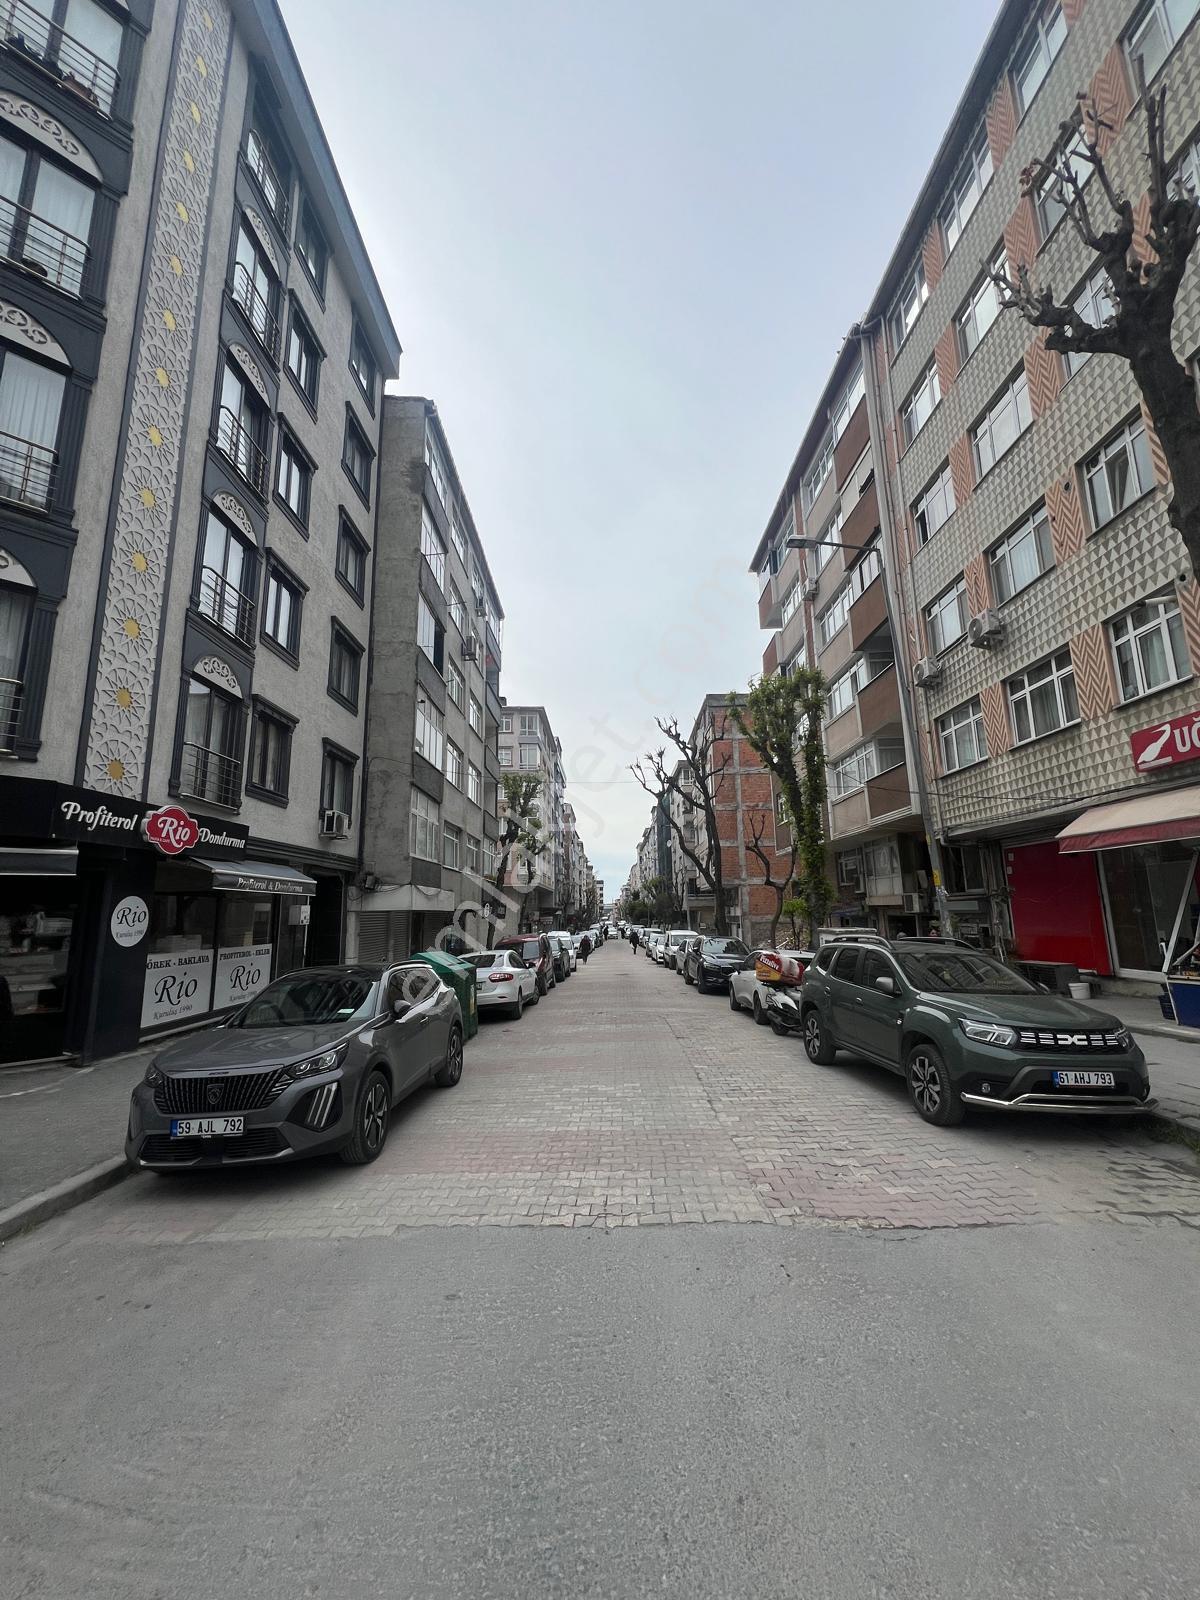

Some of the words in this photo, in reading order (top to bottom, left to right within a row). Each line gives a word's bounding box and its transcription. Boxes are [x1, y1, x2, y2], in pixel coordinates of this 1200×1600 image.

[61, 802, 138, 831] Profiterol
[158, 817, 190, 848] Rio
[200, 828, 245, 849] Dondurma
[116, 906, 147, 927] Rio
[146, 959, 172, 970] ÖREK
[230, 962, 261, 991] Rio
[154, 971, 198, 1006] Rio
[1058, 1072, 1069, 1084] 61
[1074, 1073, 1092, 1085] AHJ
[1094, 1073, 1112, 1085] 793
[178, 1121, 191, 1135] 59
[197, 1120, 216, 1134] AJL
[223, 1118, 243, 1133] 792
